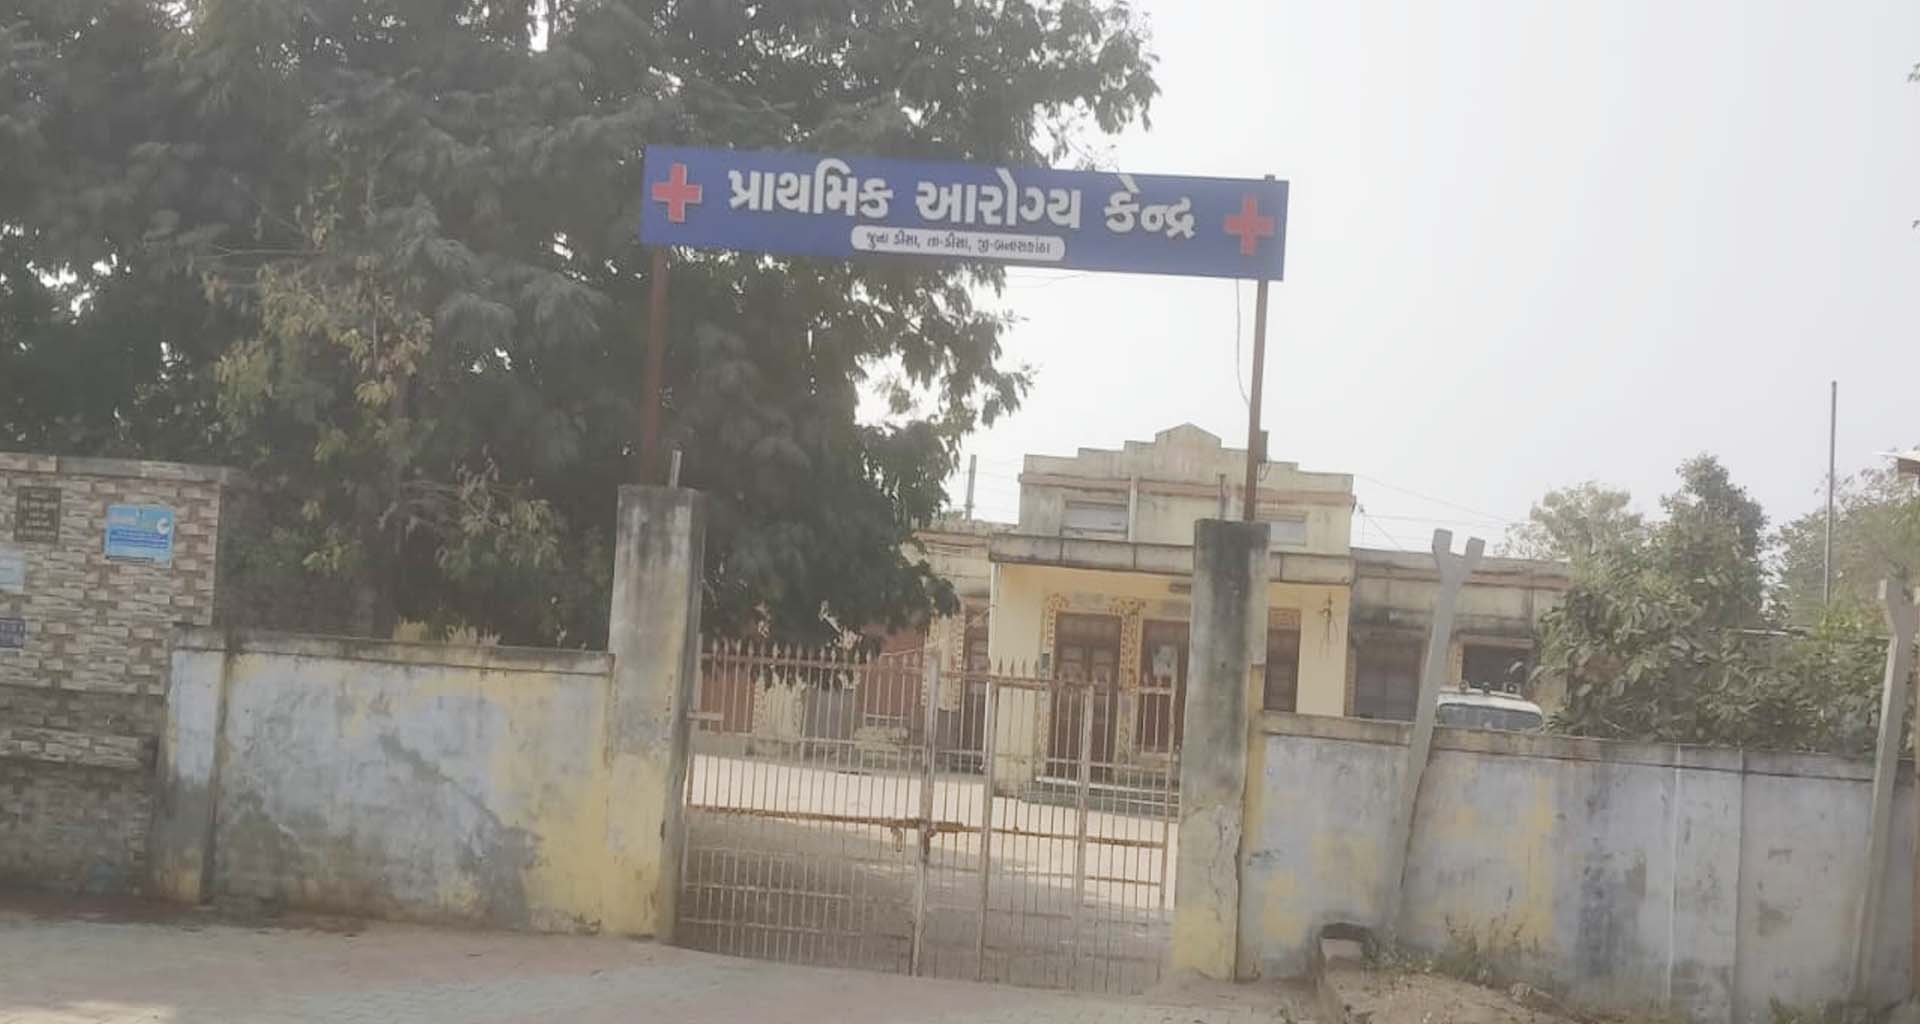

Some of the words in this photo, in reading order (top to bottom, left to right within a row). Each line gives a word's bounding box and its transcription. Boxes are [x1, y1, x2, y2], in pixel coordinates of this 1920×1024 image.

[728, 158, 894, 219] પ્રાથમિક
[915, 167, 1081, 229] આરોગ્ય
[1104, 174, 1196, 239] કેન્દ્ર
